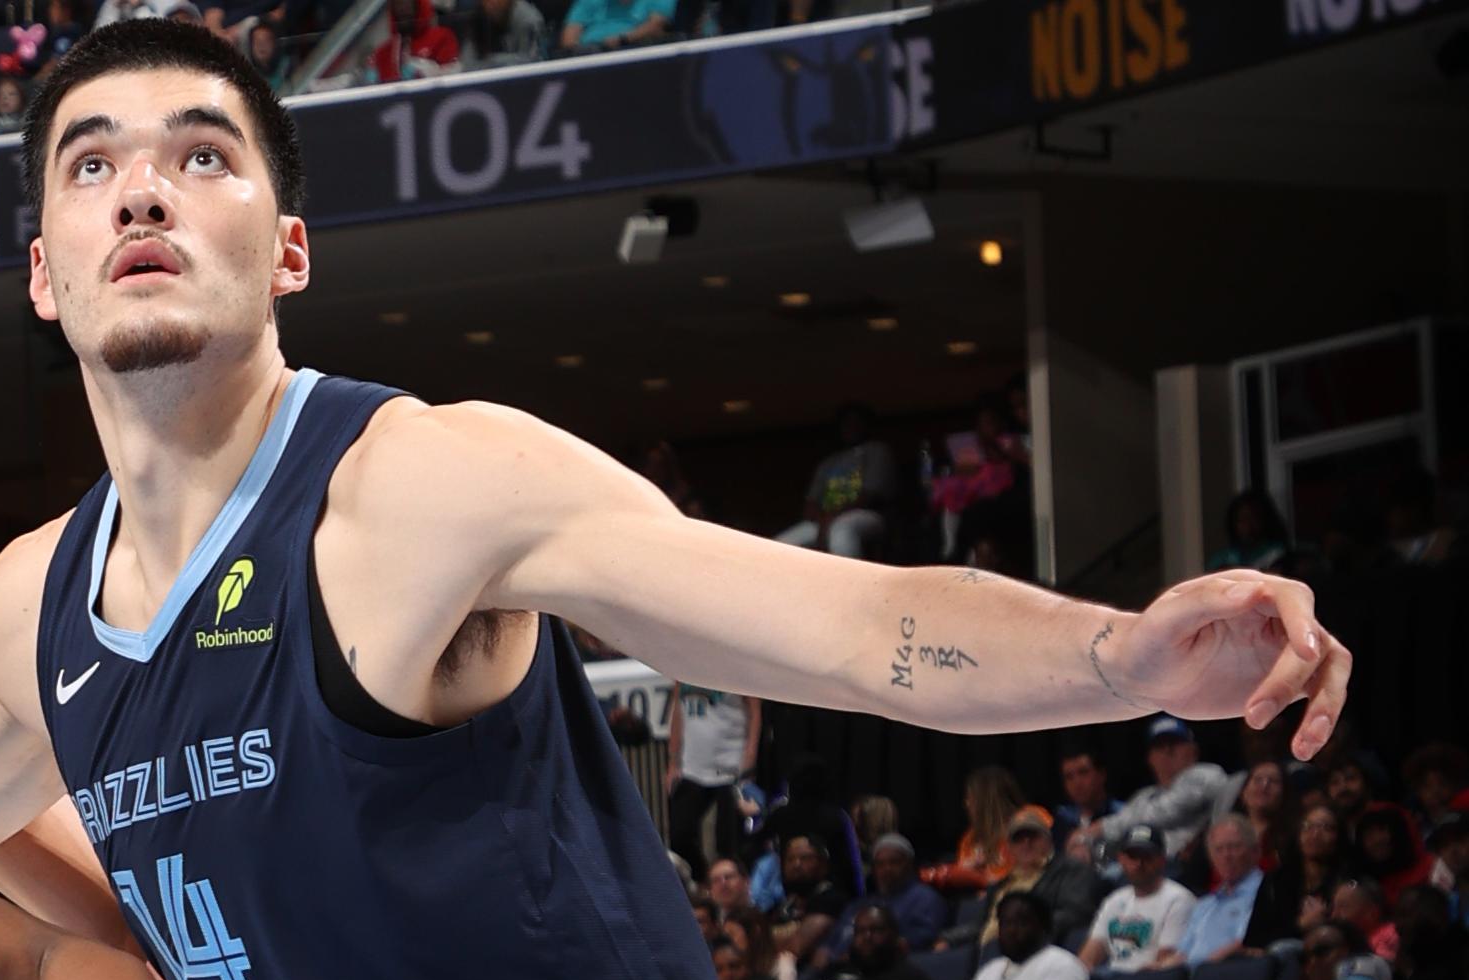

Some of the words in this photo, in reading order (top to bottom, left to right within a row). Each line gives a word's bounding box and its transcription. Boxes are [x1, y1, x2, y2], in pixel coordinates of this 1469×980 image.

[1031, 0, 1190, 102] NOISE
[380, 81, 591, 199] 104
[196, 623, 273, 649] Robinhood
[72, 727, 276, 843] RIZZLIES
